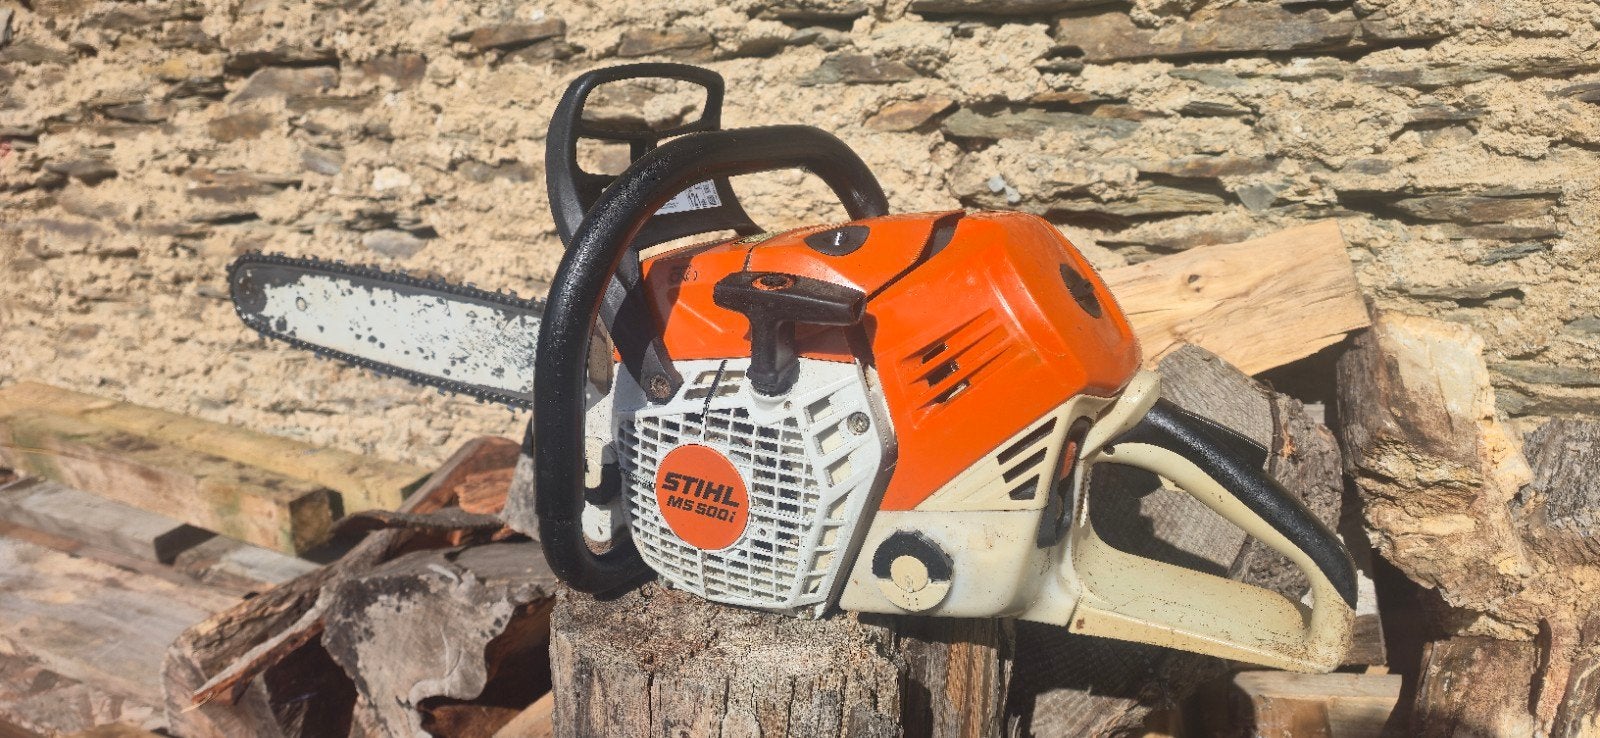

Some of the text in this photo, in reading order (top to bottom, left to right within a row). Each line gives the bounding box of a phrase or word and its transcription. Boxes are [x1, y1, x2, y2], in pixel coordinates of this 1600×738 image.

[662, 471, 740, 508] STIHL
[666, 495, 736, 524] MS 500i
